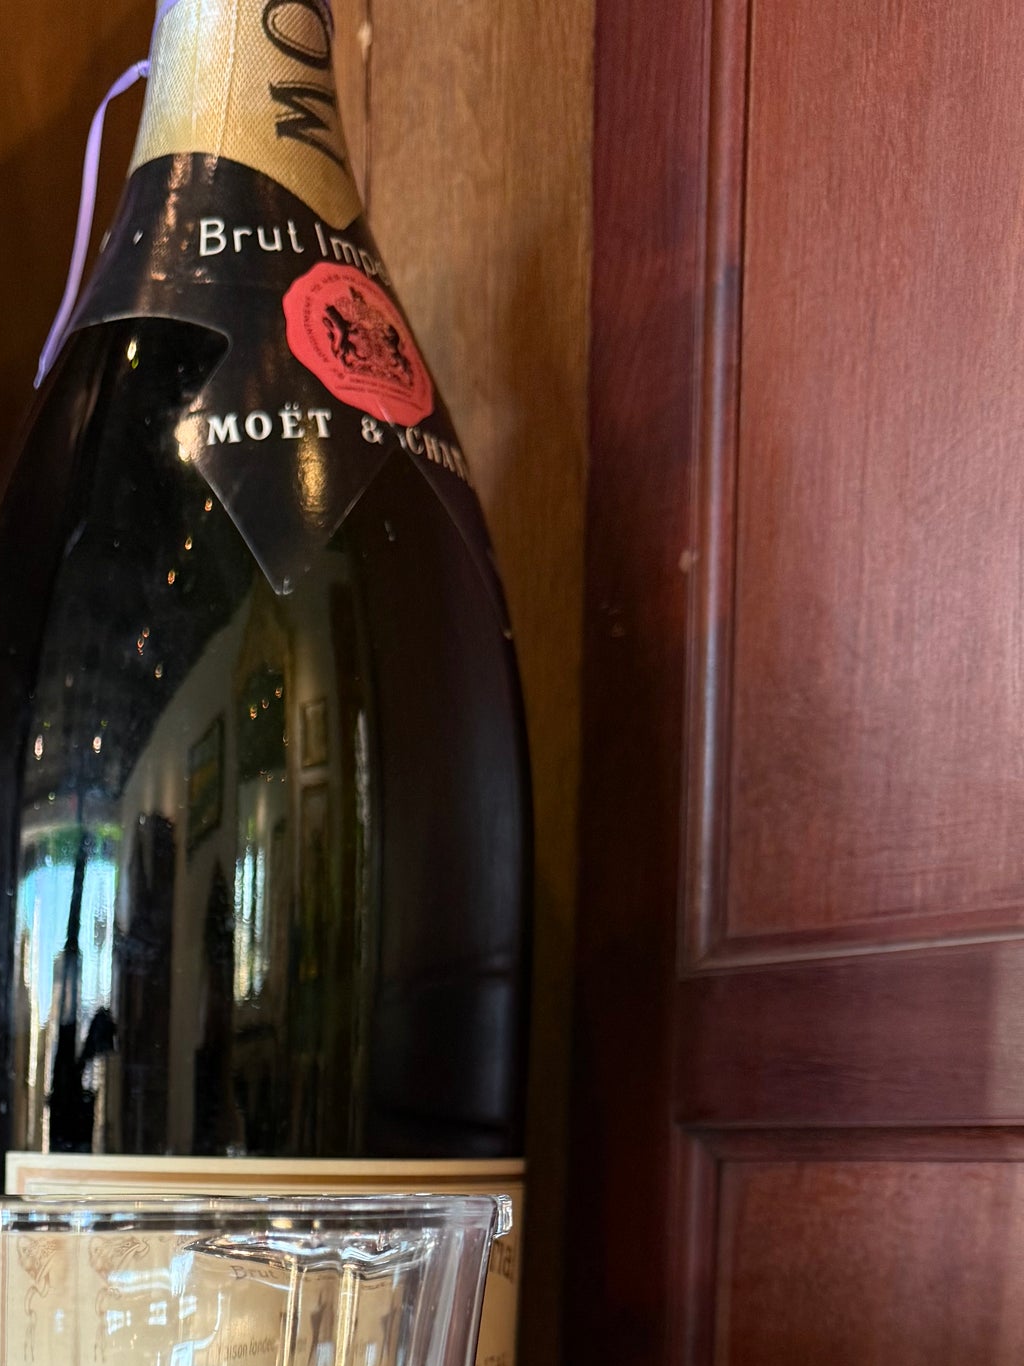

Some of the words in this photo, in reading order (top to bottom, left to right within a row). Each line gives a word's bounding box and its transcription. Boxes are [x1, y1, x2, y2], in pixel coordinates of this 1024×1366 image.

[199, 217, 305, 257] Brut
[207, 402, 332, 446] MOËT
[361, 414, 384, 445] &
